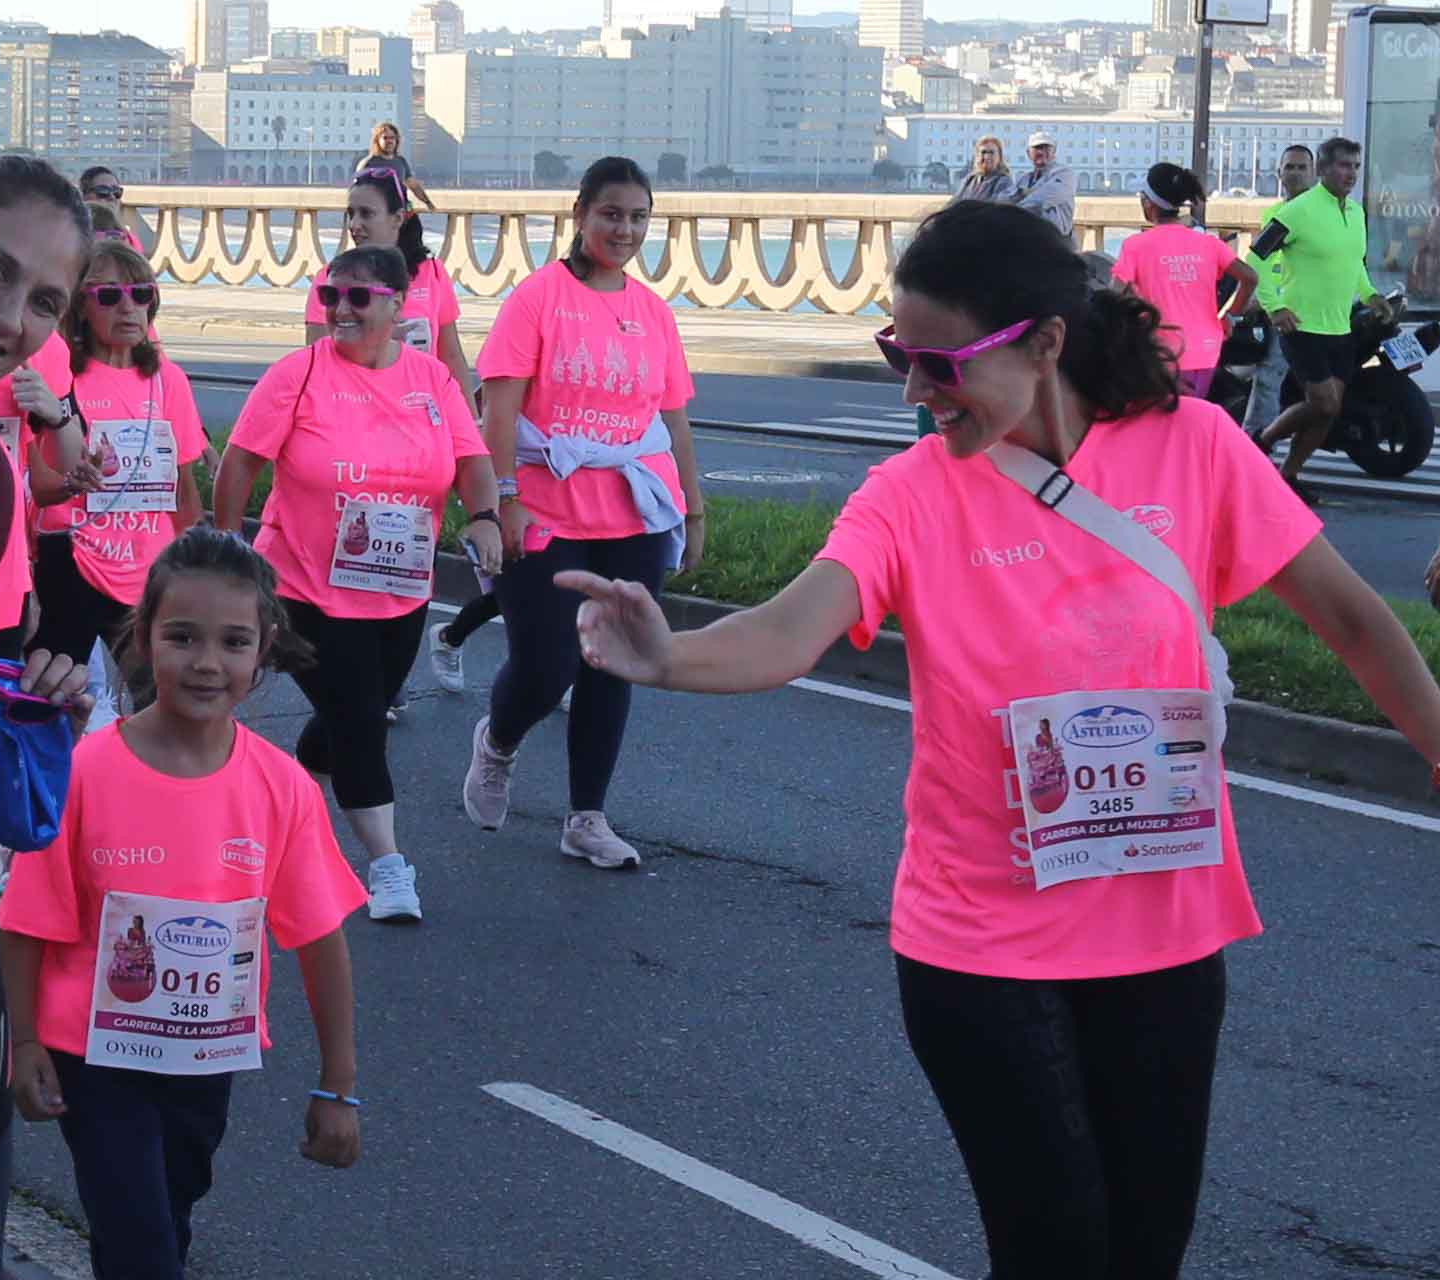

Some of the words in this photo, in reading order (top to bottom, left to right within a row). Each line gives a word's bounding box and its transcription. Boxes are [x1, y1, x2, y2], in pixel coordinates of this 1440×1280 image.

[332, 461, 367, 483] TU
[71, 507, 161, 534] DORSAL
[372, 539, 405, 553] 016
[1162, 711, 1203, 720] SUMA
[1070, 722, 1147, 739] ASTURIANA
[1074, 762, 1146, 790] 016
[1089, 797, 1134, 815] 3485
[1040, 826, 1086, 842] CARRERA
[1089, 824, 1104, 833] DE
[1109, 822, 1124, 832] LA
[1126, 819, 1168, 831] MUJER
[92, 846, 166, 865] OYSHO
[1140, 840, 1204, 856] Santander
[1041, 850, 1089, 872] OYSHO
[161, 968, 220, 995] 016
[170, 1001, 209, 1018] 3488
[113, 1017, 164, 1033] CARRERA
[167, 1024, 182, 1034] DE
[185, 1025, 198, 1035] LA
[105, 1040, 163, 1059] OYSHO
[207, 1045, 248, 1061] Santander
